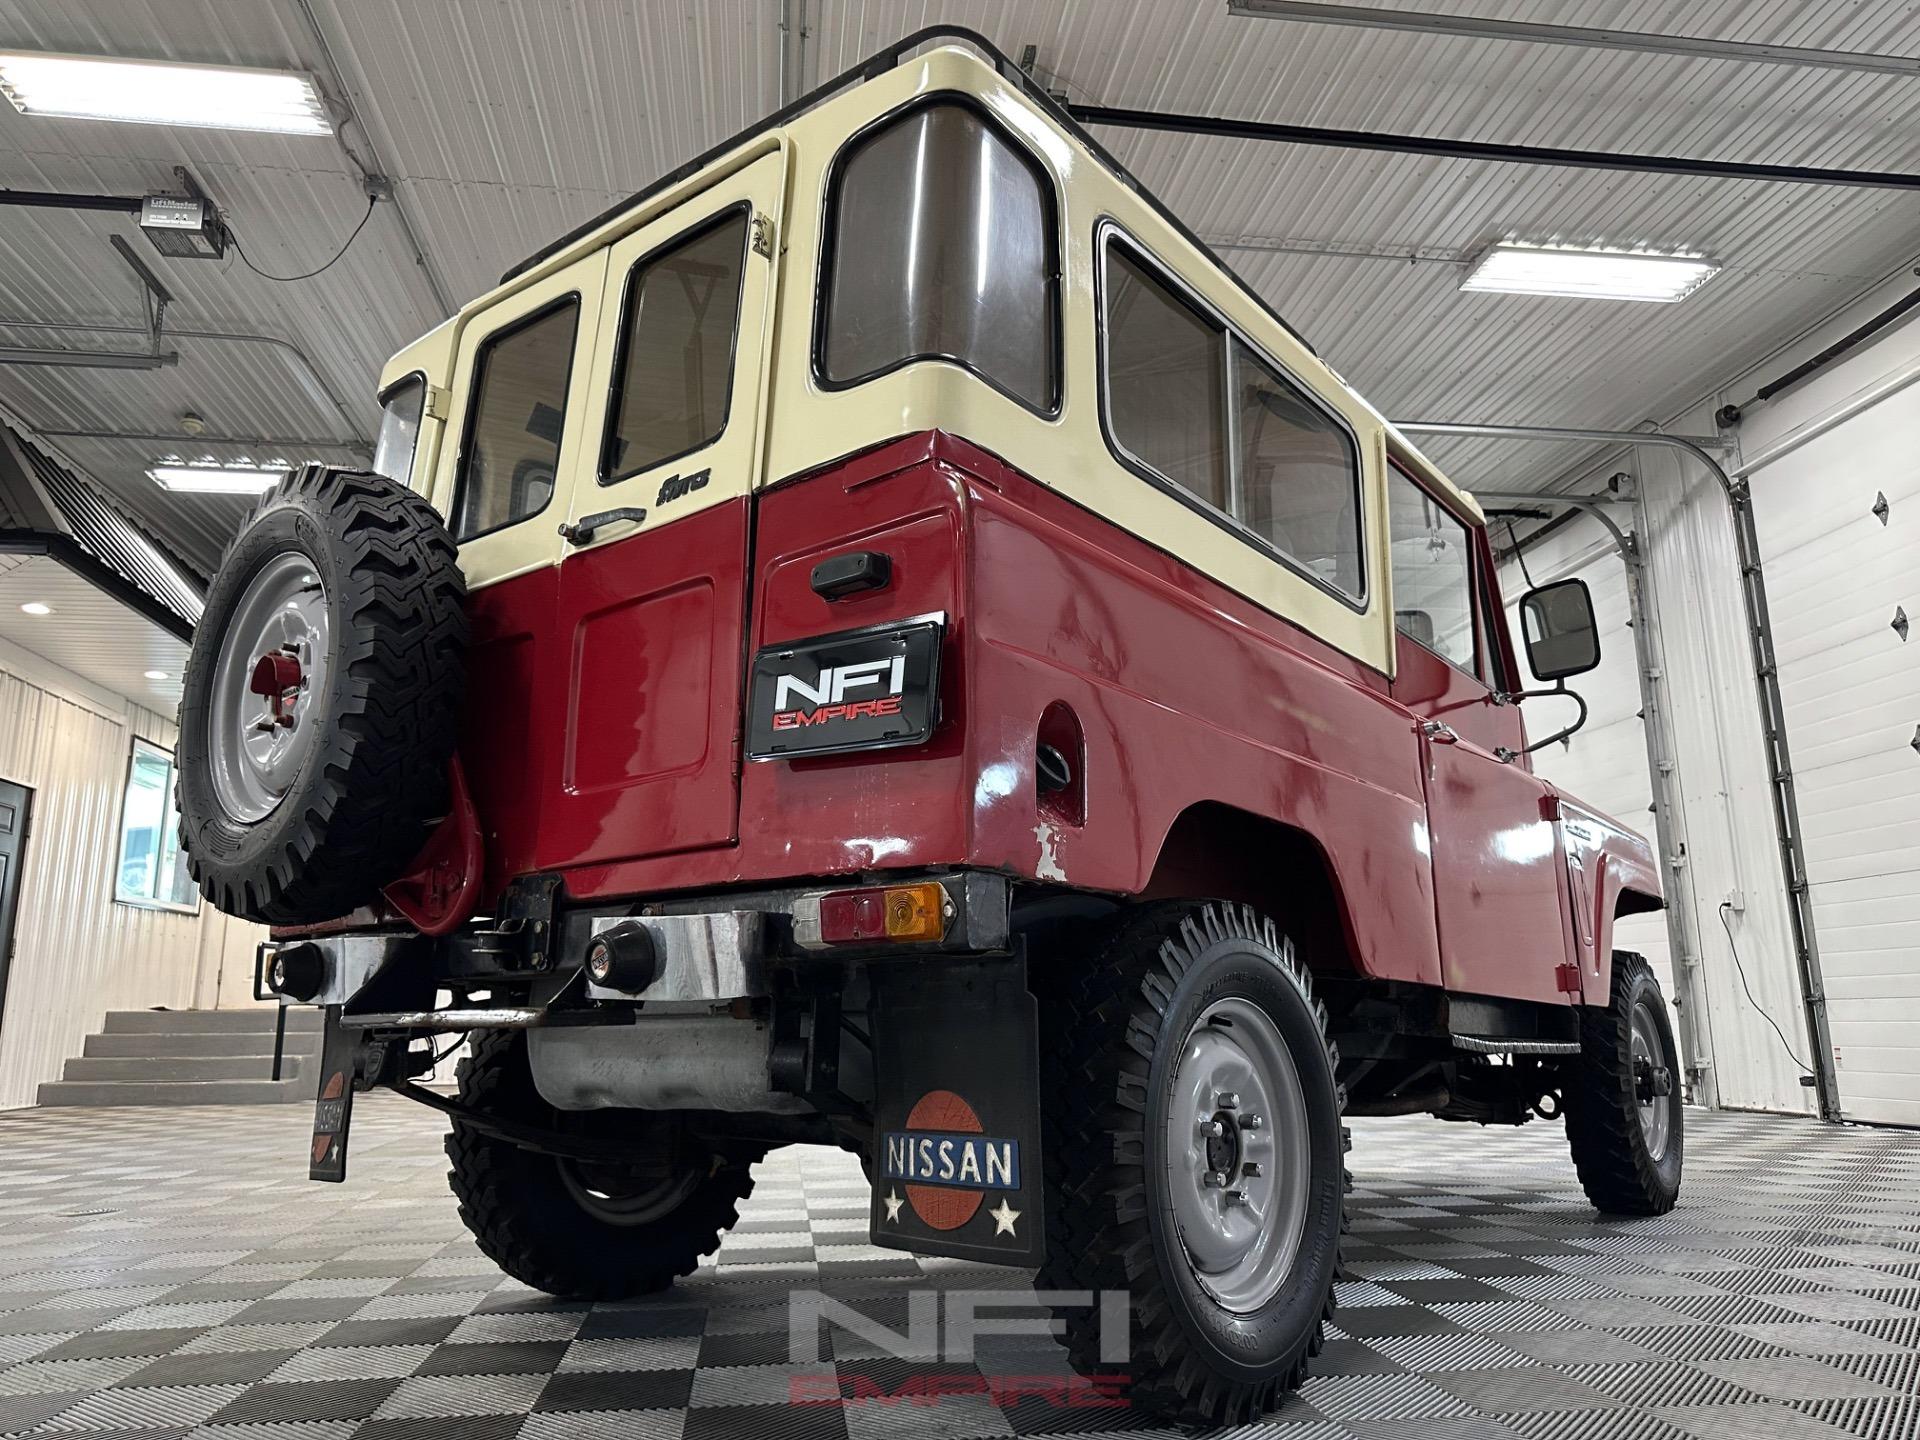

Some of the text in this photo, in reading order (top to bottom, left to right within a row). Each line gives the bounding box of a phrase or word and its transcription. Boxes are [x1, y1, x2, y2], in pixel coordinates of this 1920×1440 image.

[775, 654, 906, 711] NFI
[773, 695, 903, 731] EMPIRE
[888, 1136, 1012, 1185] NISSAN
